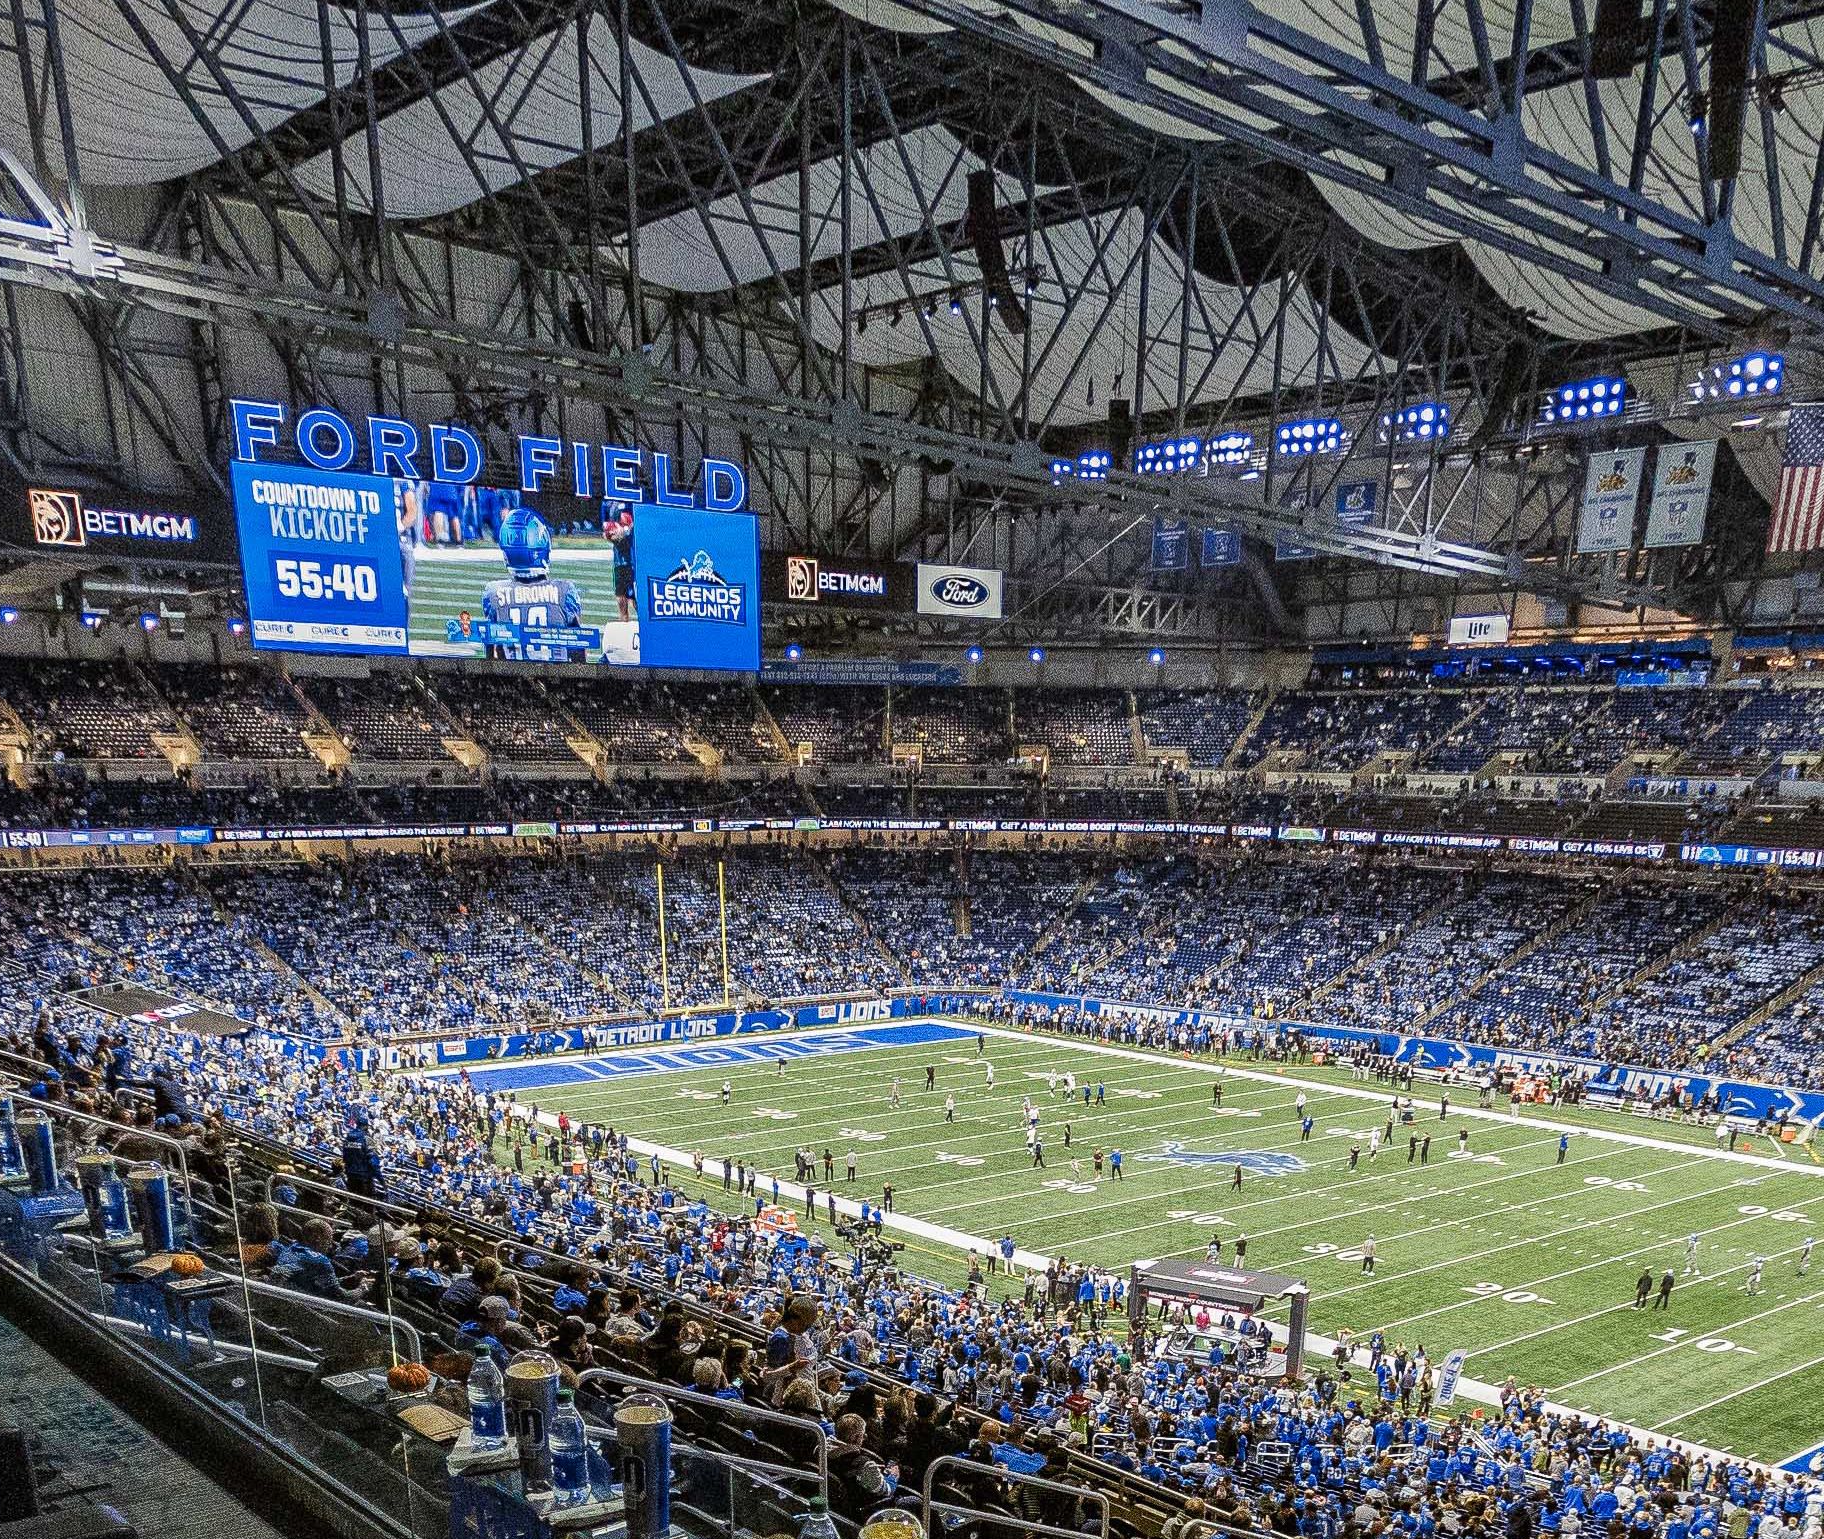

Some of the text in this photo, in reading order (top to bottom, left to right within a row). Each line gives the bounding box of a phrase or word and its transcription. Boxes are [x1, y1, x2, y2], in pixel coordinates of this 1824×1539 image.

[229, 398, 747, 512] FORD FIELD
[252, 480, 381, 515] COUNTDOWN TO
[84, 507, 194, 543] BETMGM
[269, 505, 370, 545] KICKOFF
[276, 560, 377, 601] 55:40
[817, 573, 884, 595] BETMGM
[941, 578, 980, 604] Ford
[514, 586, 559, 605] BROWN
[652, 582, 742, 606] LEGENDS
[654, 600, 741, 621] COMMUNITY
[1468, 623, 1491, 639] Lite
[955, 820, 997, 830] BETMGM
[1001, 822, 1020, 830] GET
[1237, 825, 1272, 837] BETMGM
[1339, 830, 1376, 843] BETMGM
[1514, 839, 1559, 852] BETMGM
[1562, 842, 1583, 852] GET
[838, 998, 892, 1024] LIONS
[596, 1022, 667, 1047] DETROIT
[1461, 1282, 1533, 1305] 20
[1649, 1326, 1737, 1355] 10
